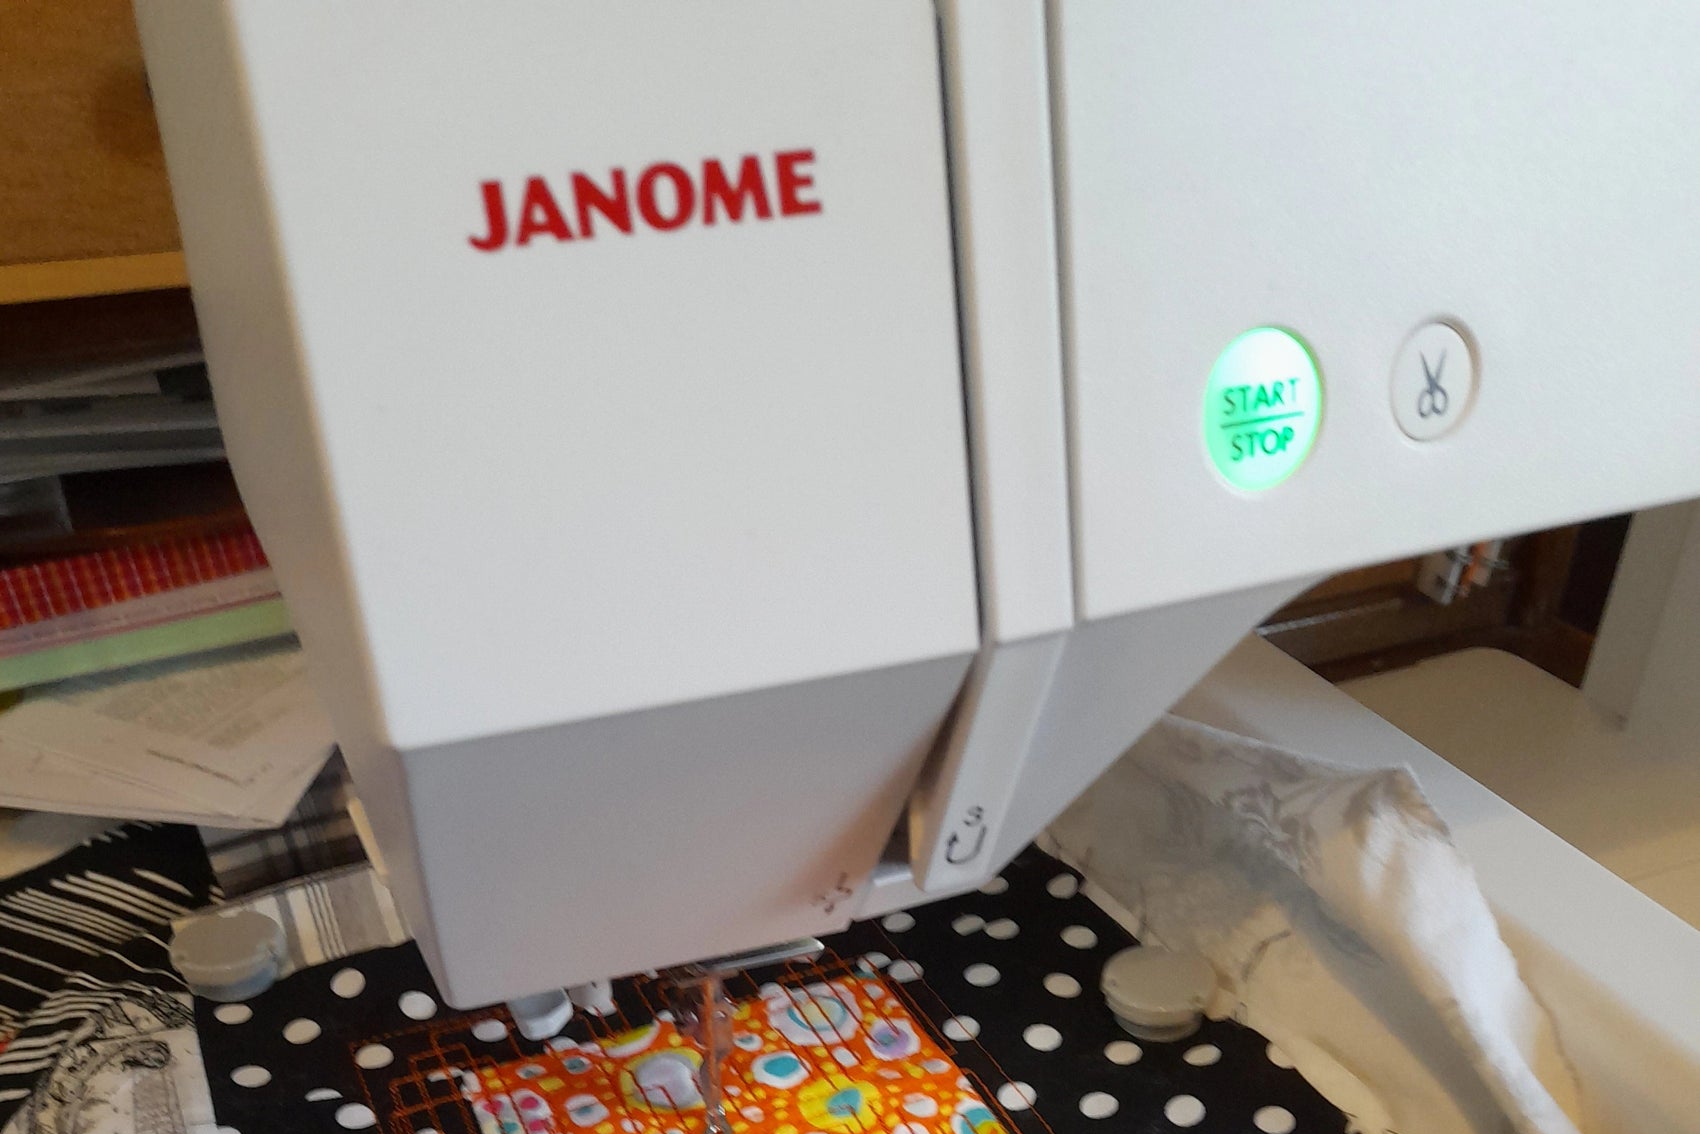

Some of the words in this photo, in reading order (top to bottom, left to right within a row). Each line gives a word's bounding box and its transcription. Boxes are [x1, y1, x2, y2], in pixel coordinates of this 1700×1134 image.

[467, 148, 822, 253] JANOME
[1223, 378, 1299, 416] START
[1230, 426, 1294, 461] STOP
